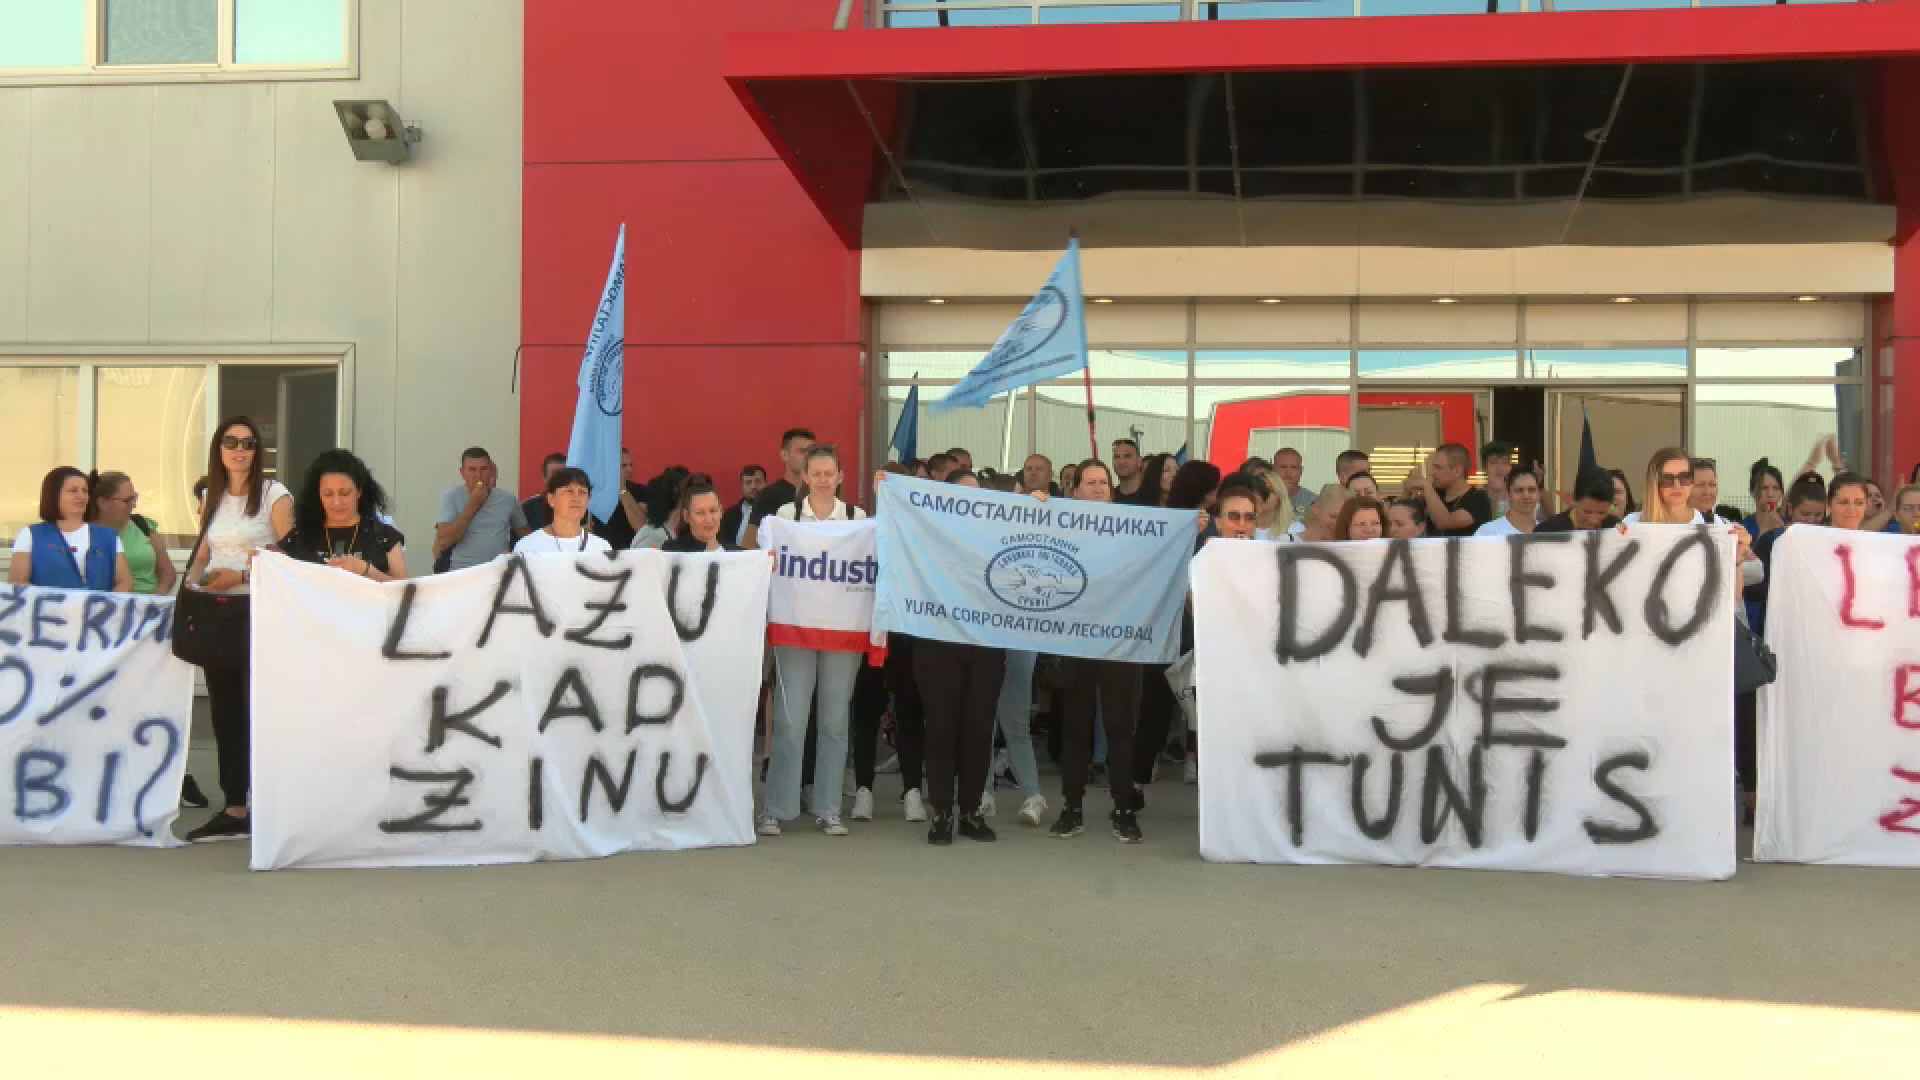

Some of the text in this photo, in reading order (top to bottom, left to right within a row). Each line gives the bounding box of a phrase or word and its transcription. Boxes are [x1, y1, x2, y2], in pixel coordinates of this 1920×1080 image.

[909, 491, 1168, 537] САМОСТАЛНИ СИНДИКАТ
[904, 598, 1153, 644] YURA CORPORATION ЛЕСКОВАЦ
[1275, 526, 1722, 665] DALEKO
[424, 663, 685, 753] KAD
[1371, 664, 1567, 751] JE
[1254, 743, 1659, 848] TUNIS
